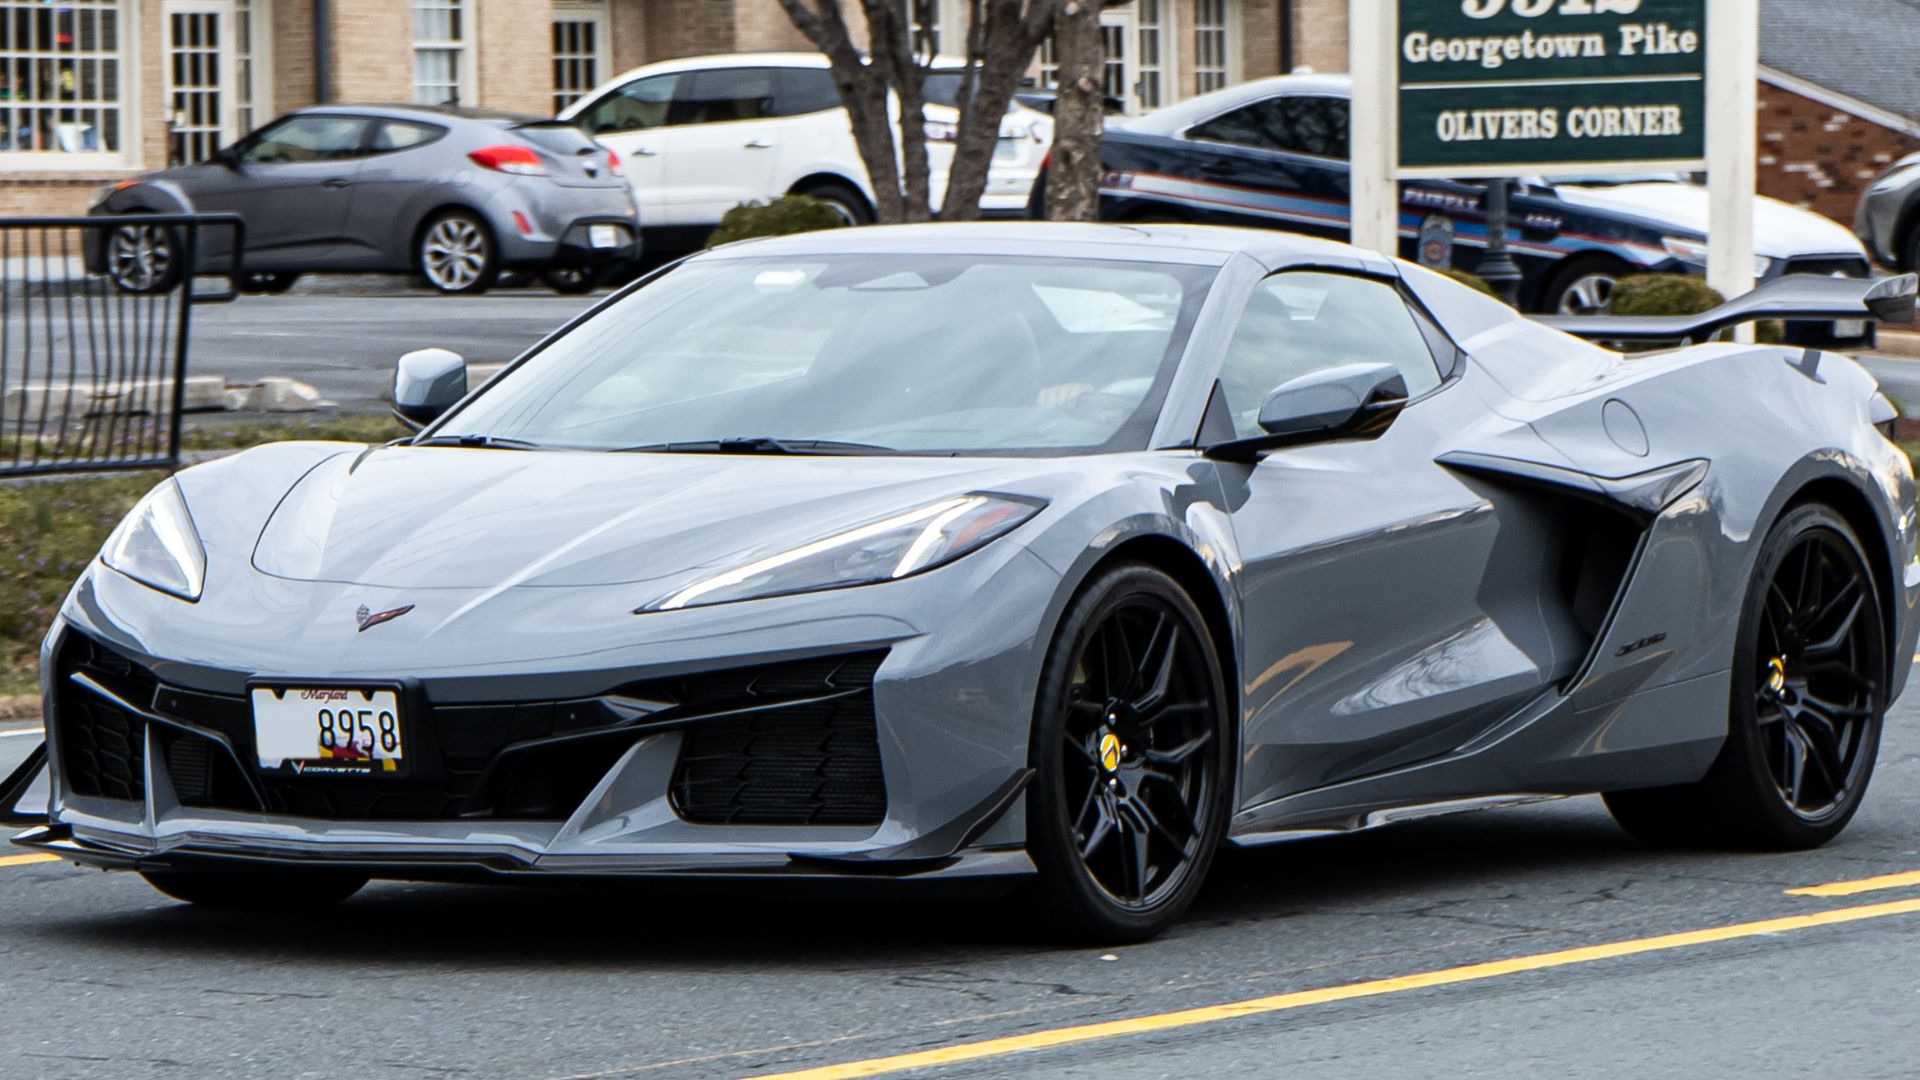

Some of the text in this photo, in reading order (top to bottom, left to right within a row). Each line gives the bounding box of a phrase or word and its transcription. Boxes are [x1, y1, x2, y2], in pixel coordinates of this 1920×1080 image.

[1403, 23, 1698, 69] Georgetown Pike
[1436, 104, 1683, 142] OLIVERS CORNER
[301, 689, 348, 704] Maryland
[318, 708, 398, 753] 8958
[303, 766, 371, 774] CORVETTE
